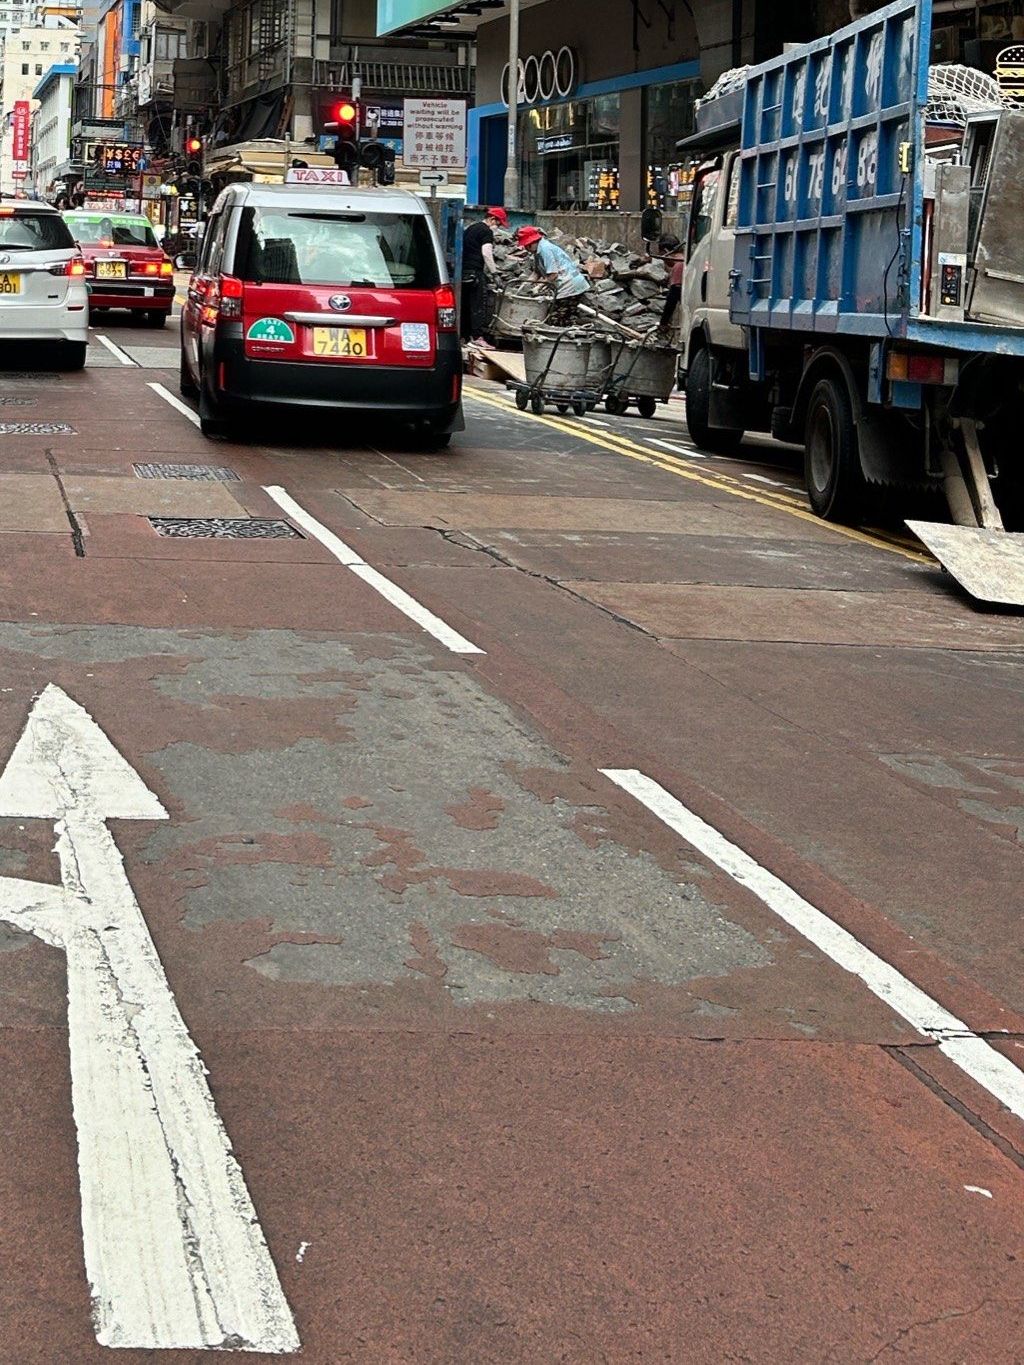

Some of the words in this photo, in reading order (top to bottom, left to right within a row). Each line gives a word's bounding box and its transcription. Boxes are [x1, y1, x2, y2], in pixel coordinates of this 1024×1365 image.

[293, 169, 345, 183] TAXI
[267, 326, 276, 335] 4
[328, 330, 352, 342] WA
[318, 341, 364, 355] 7440
